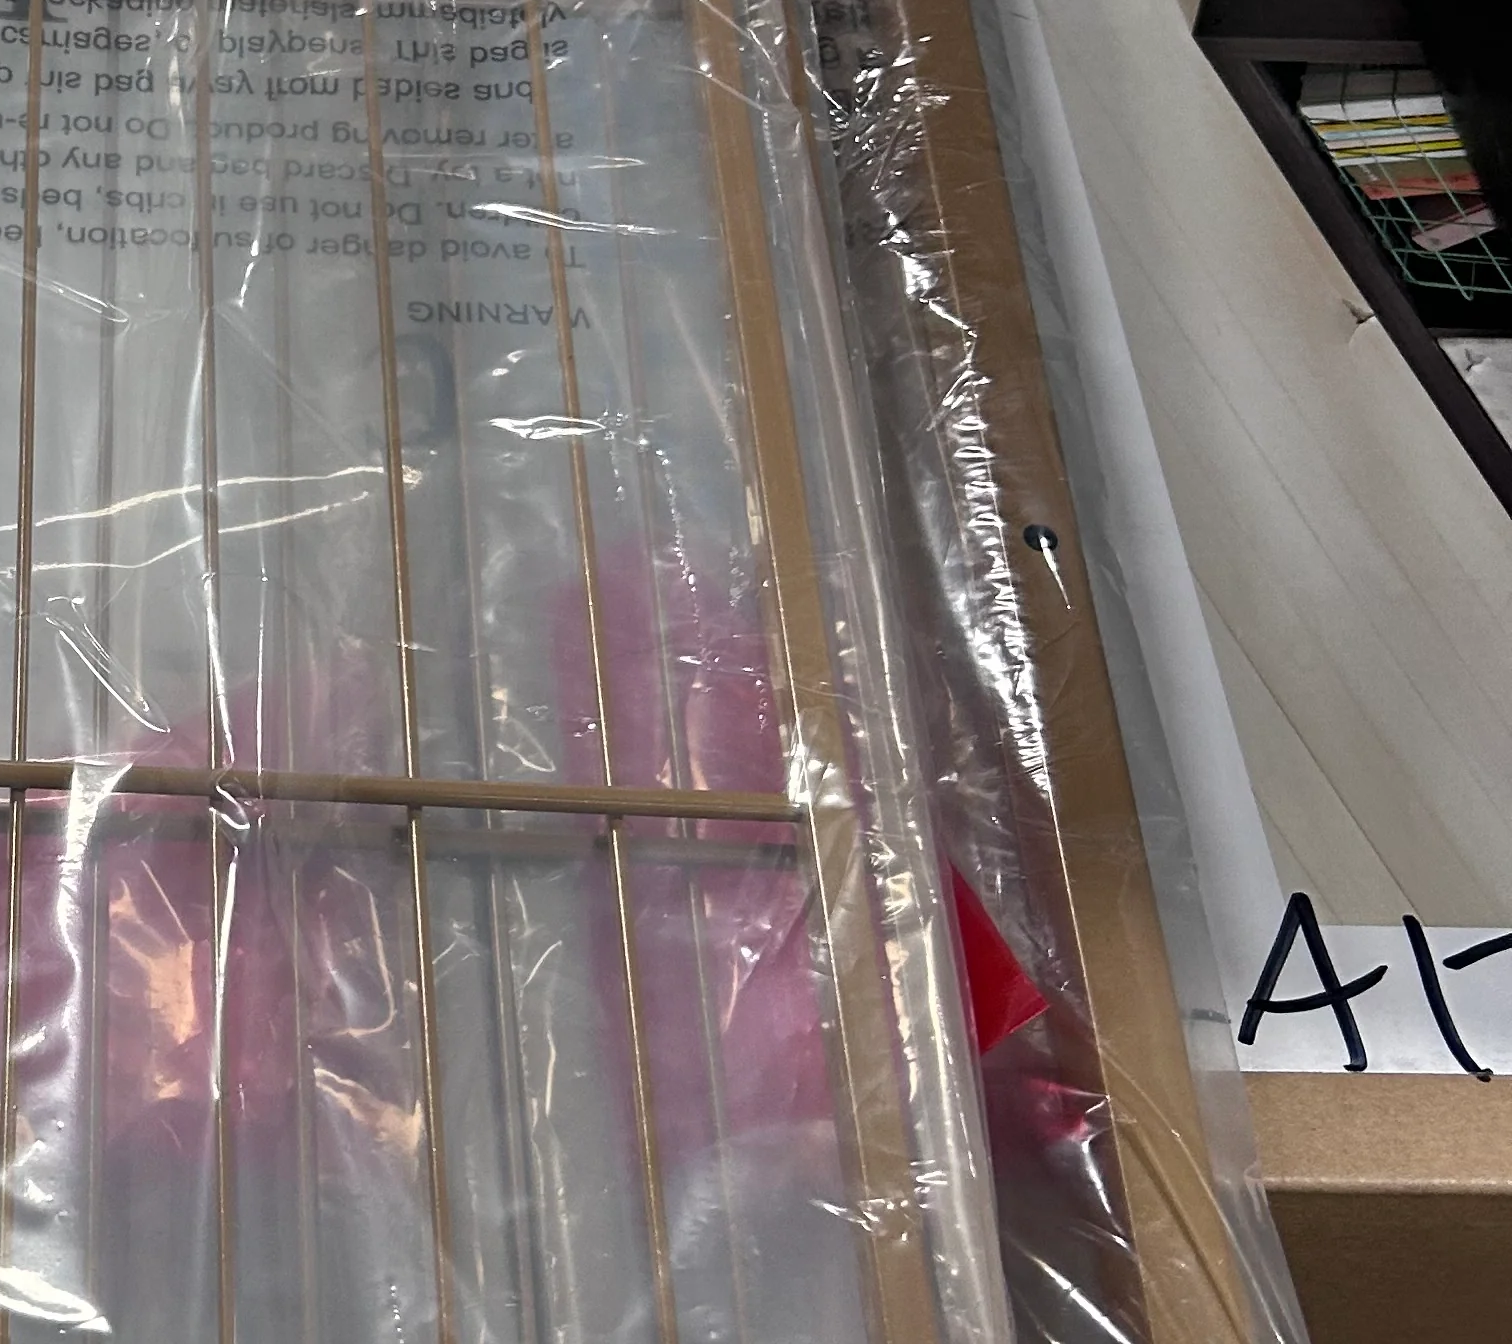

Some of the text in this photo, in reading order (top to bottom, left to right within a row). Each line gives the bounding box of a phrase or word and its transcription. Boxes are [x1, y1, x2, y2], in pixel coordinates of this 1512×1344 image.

[61, 115, 113, 136] not
[125, 118, 170, 142] Do
[332, 121, 486, 150] removng
[62, 146, 122, 172] any
[136, 155, 196, 177] and
[285, 159, 412, 187] Dscard
[494, 167, 512, 184] a
[522, 166, 576, 190] nt
[96, 186, 186, 215] cribs,
[240, 196, 299, 216] use
[309, 199, 361, 224] not
[58, 223, 251, 252] sufocation,
[263, 232, 294, 254] of
[441, 239, 531, 263] avoid
